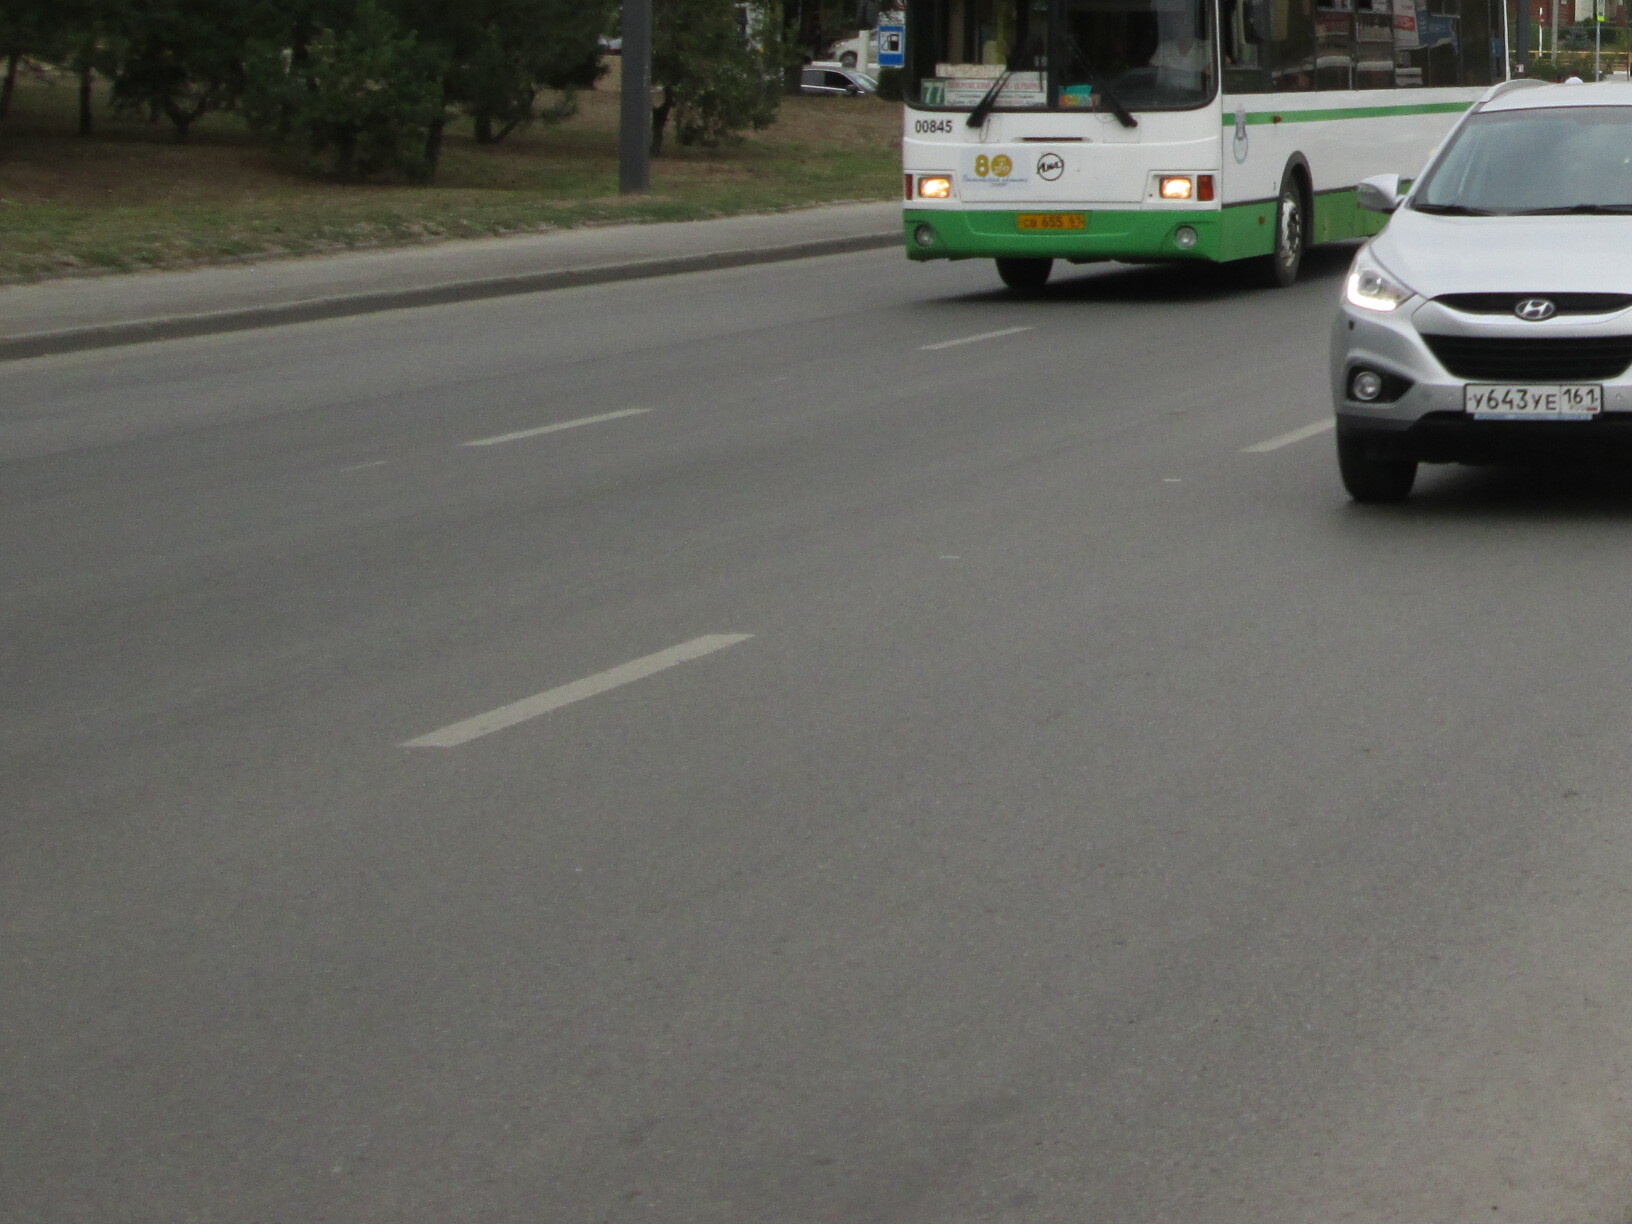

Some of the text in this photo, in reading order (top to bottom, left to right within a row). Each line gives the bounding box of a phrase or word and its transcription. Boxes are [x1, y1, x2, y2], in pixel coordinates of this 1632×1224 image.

[923, 82, 945, 104] 77
[915, 120, 952, 133] 00845
[1563, 388, 1596, 405] 161
